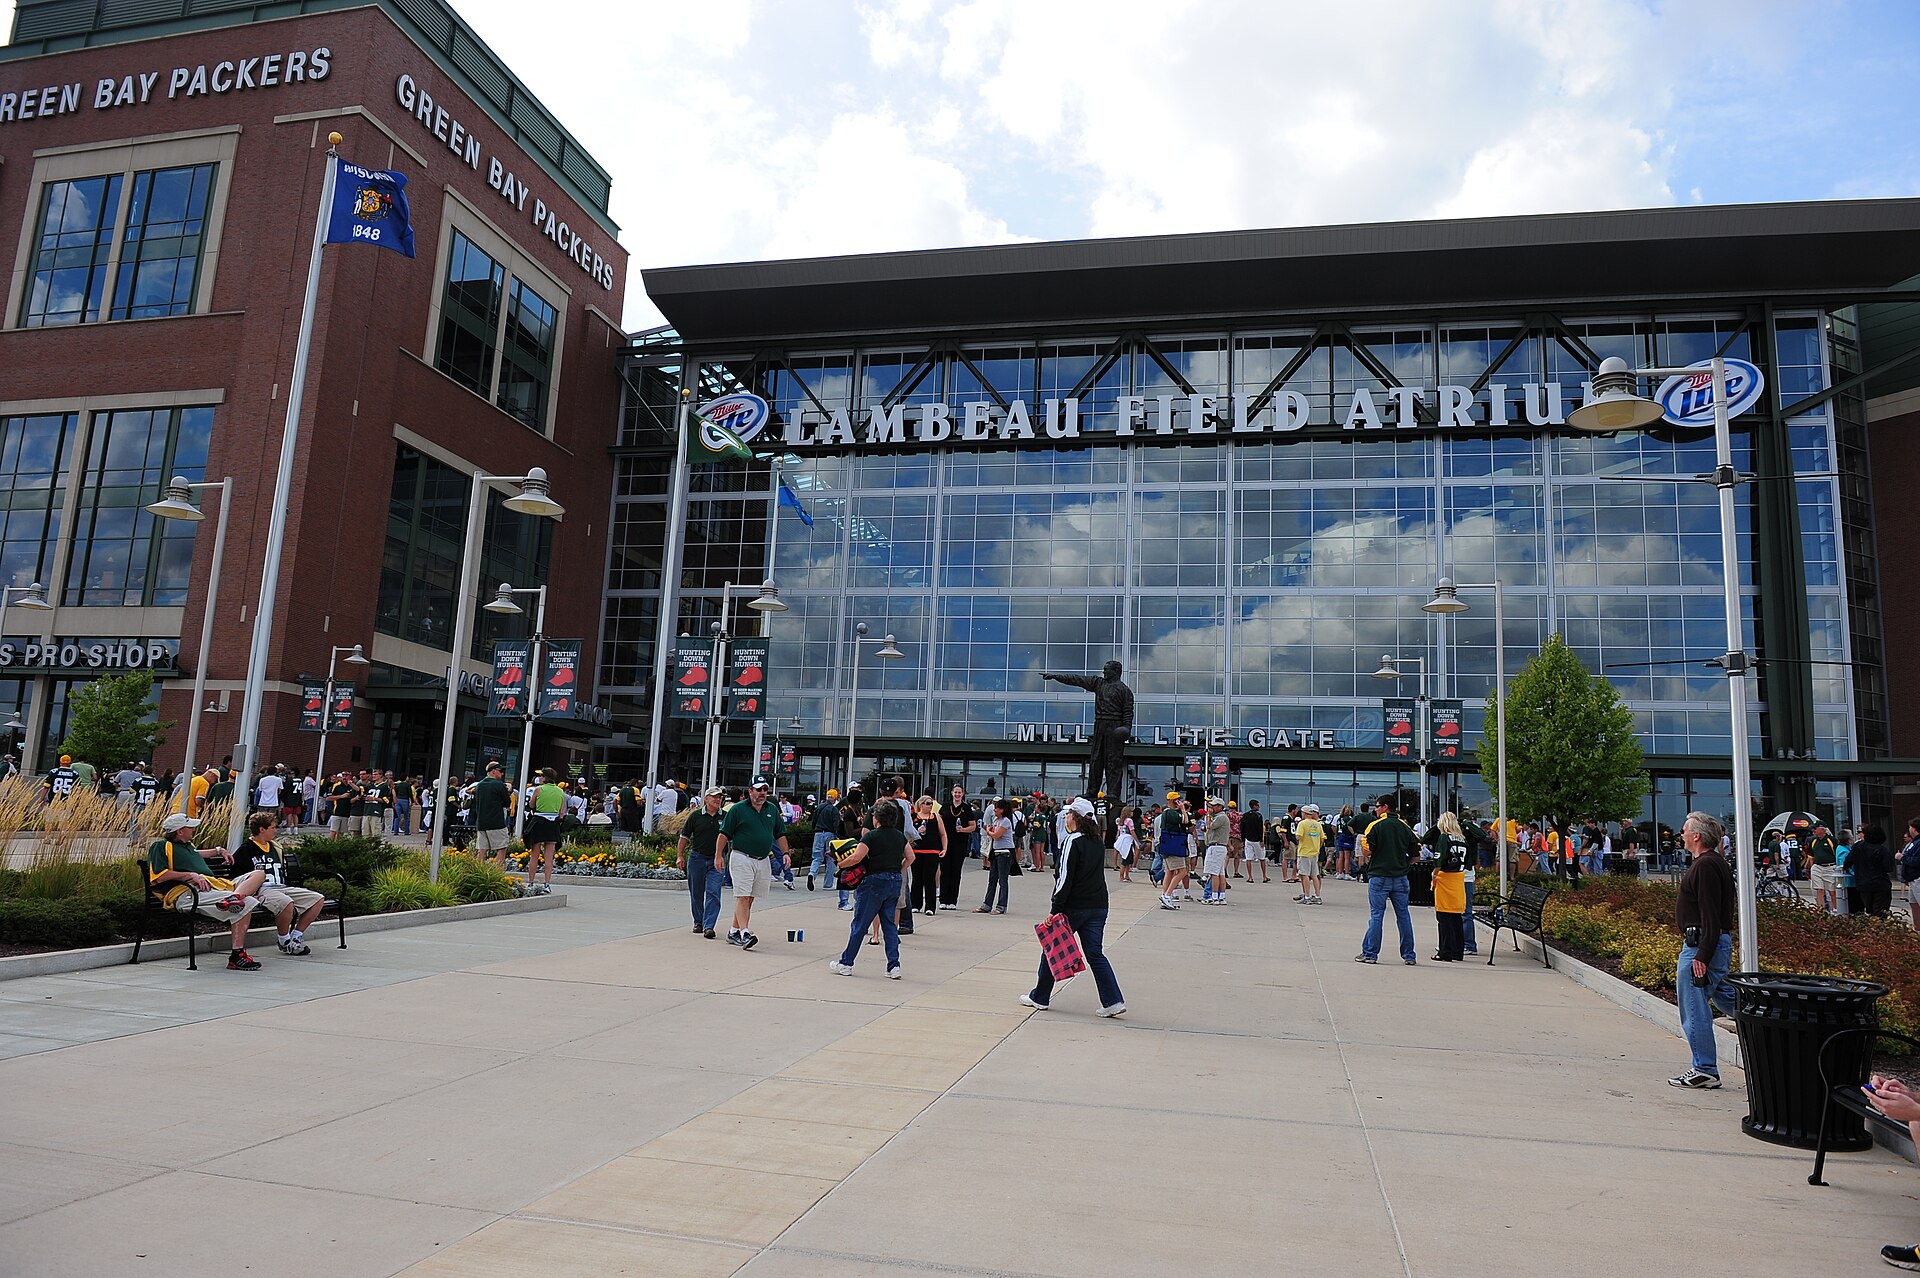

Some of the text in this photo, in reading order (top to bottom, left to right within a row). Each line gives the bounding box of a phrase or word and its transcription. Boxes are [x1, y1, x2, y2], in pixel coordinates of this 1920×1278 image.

[94, 71, 159, 110] BAY
[168, 47, 332, 99] PACKERS
[396, 74, 614, 291] GREEN BAY PACKERS
[353, 224, 380, 240] 1848
[787, 381, 1599, 445] LAMBEAU FIELD ATRIU
[24, 644, 80, 667] PRO
[87, 644, 166, 668] SHOP
[574, 701, 612, 726] SHOP
[1154, 726, 1226, 746] LITE
[1249, 728, 1334, 749] GATE
[52, 777, 73, 794] 85
[137, 788, 155, 804] 12
